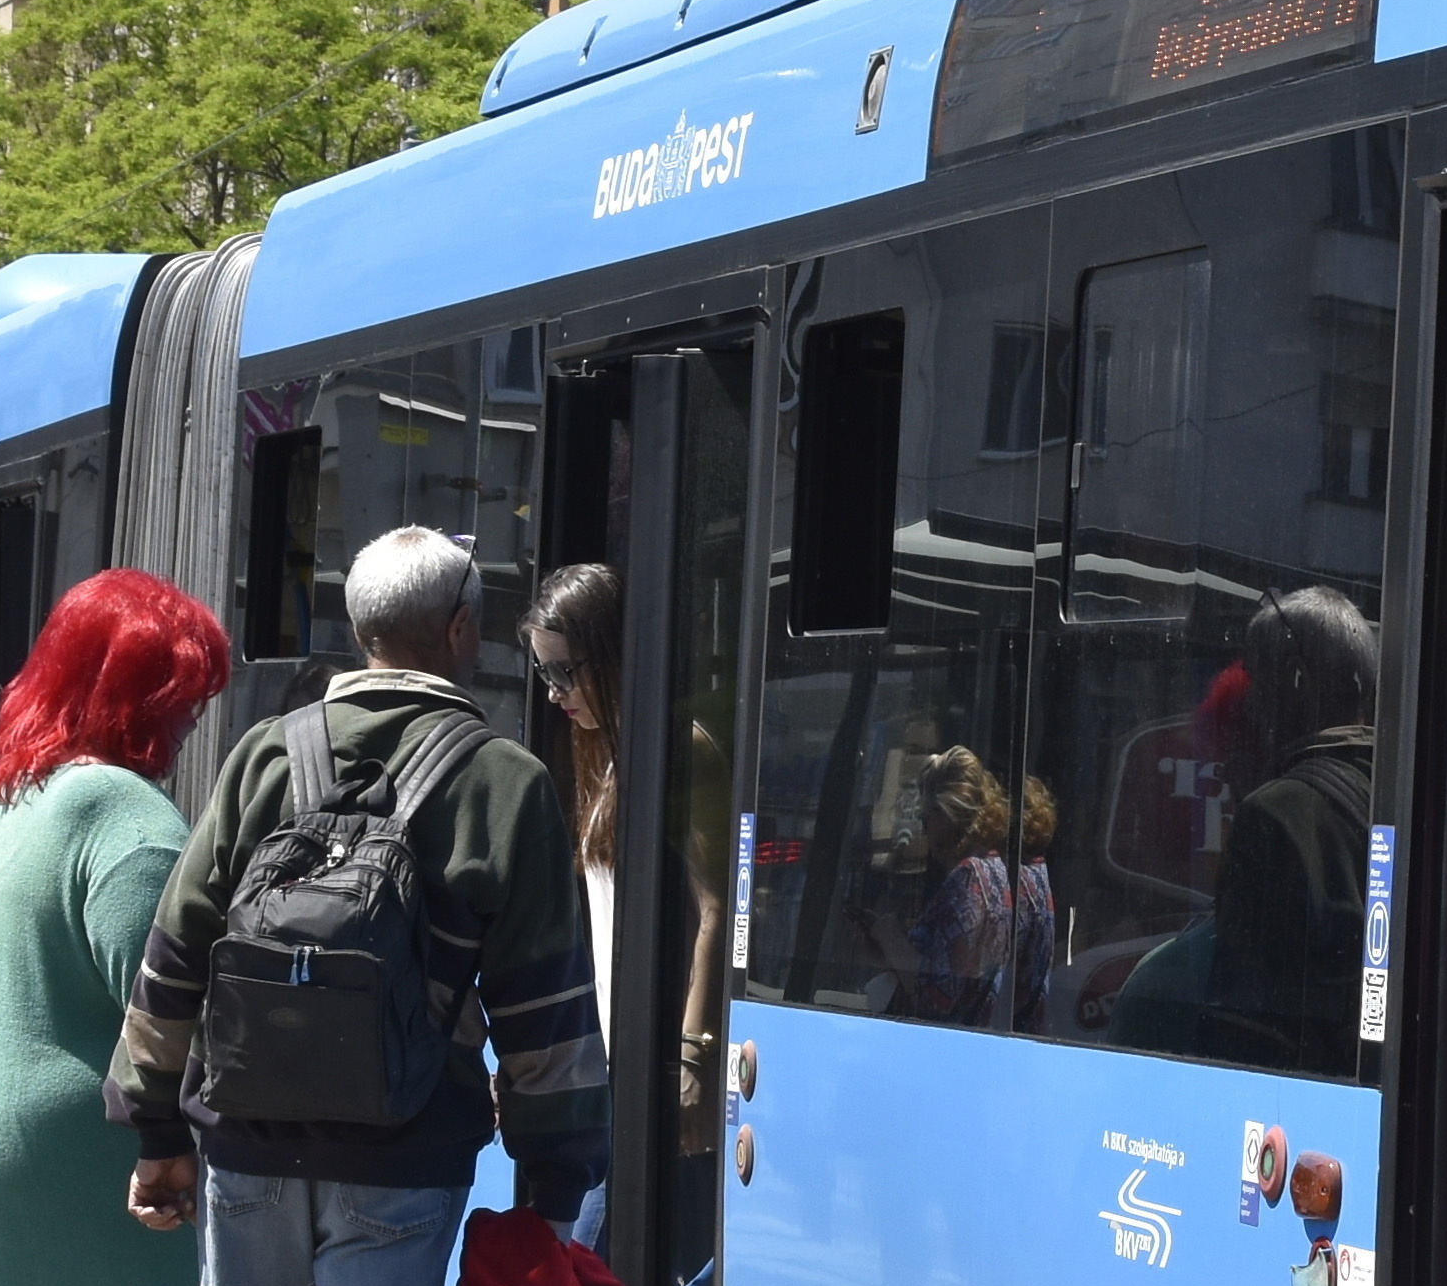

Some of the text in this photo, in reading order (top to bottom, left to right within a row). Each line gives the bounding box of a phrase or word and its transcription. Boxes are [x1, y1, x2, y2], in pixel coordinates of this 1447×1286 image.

[1102, 1129, 1185, 1170] A BKK szolgáltatója a
[1114, 1227, 1141, 1262] BKV
